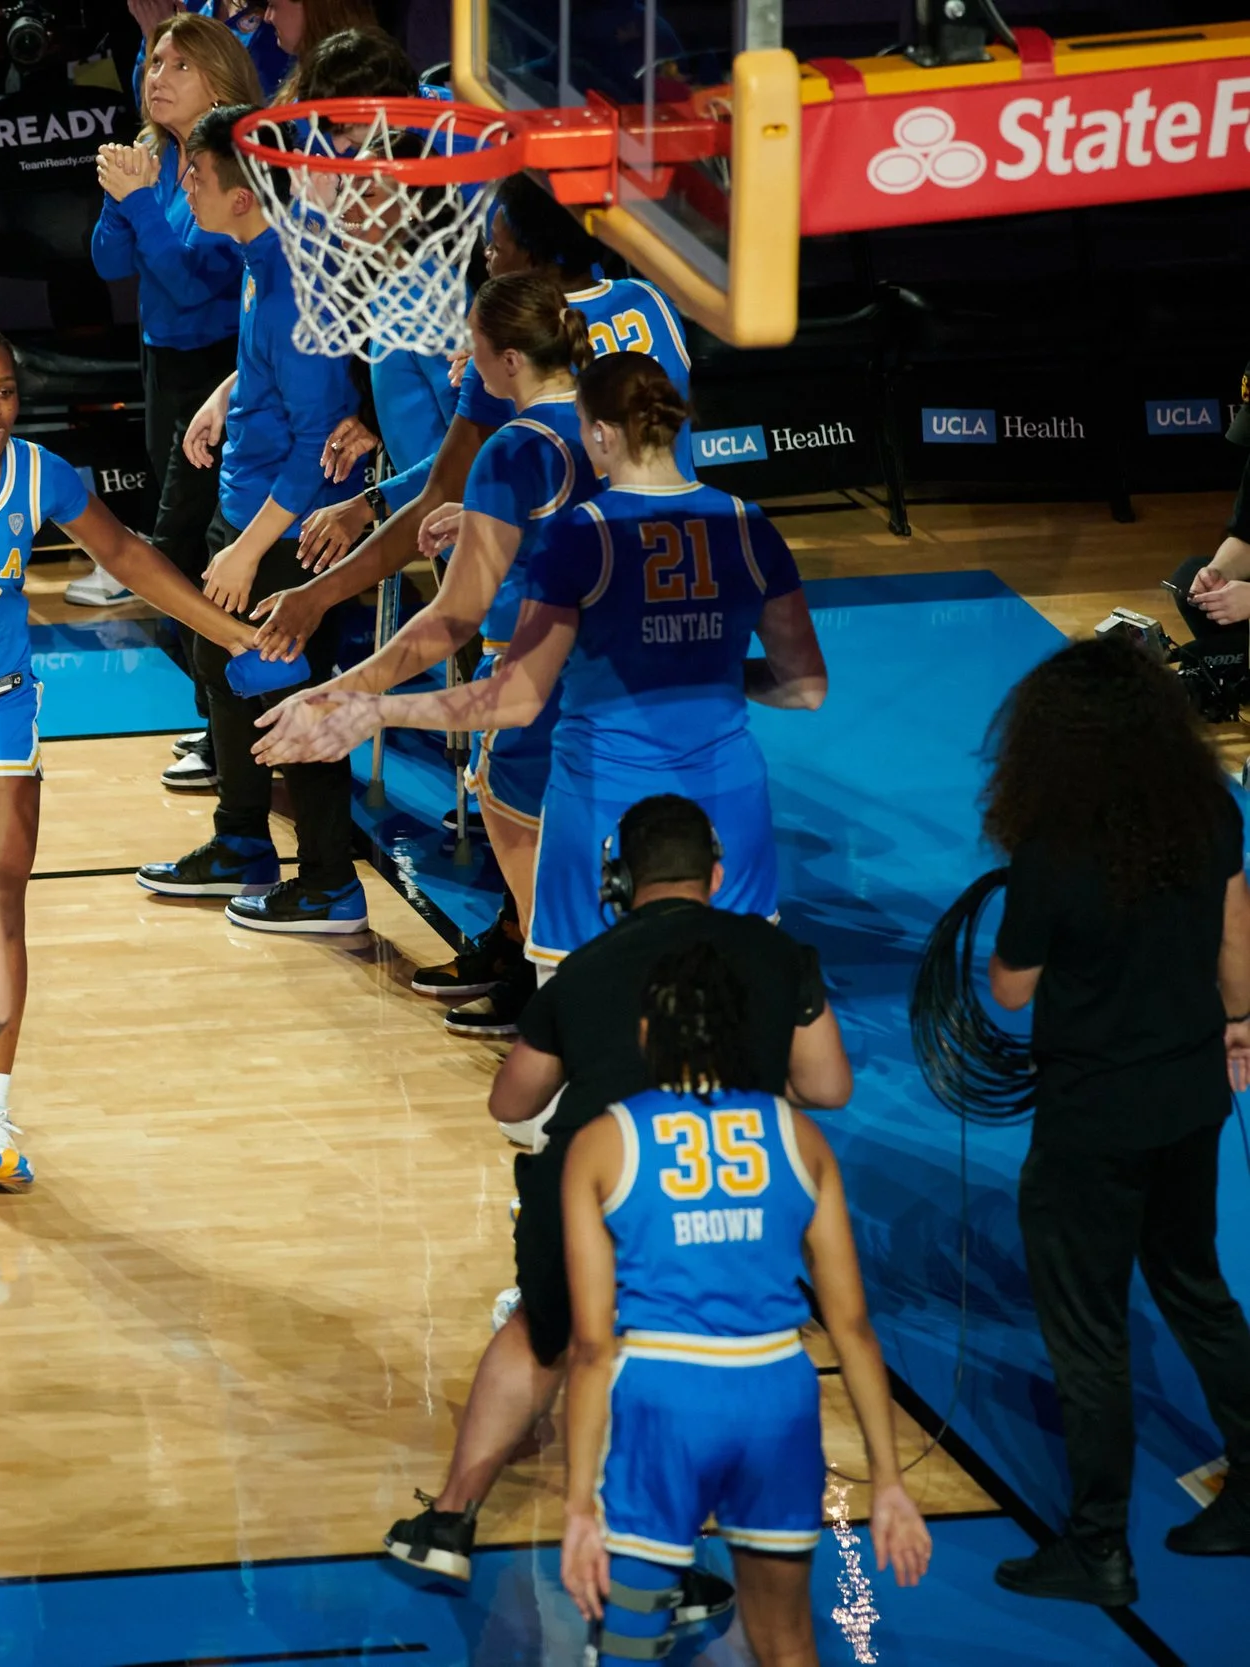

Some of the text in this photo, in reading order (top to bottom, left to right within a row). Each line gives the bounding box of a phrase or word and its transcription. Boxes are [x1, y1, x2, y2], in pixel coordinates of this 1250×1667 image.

[932, 415, 1086, 439] UCLA Health
[1156, 406, 1212, 426] UCLA
[700, 422, 856, 458] UCLA Health
[99, 468, 147, 493] Hea
[638, 518, 719, 603] 21
[641, 612, 724, 643] SONTAG
[652, 1109, 771, 1200] 35
[672, 1207, 764, 1246] BROWN
